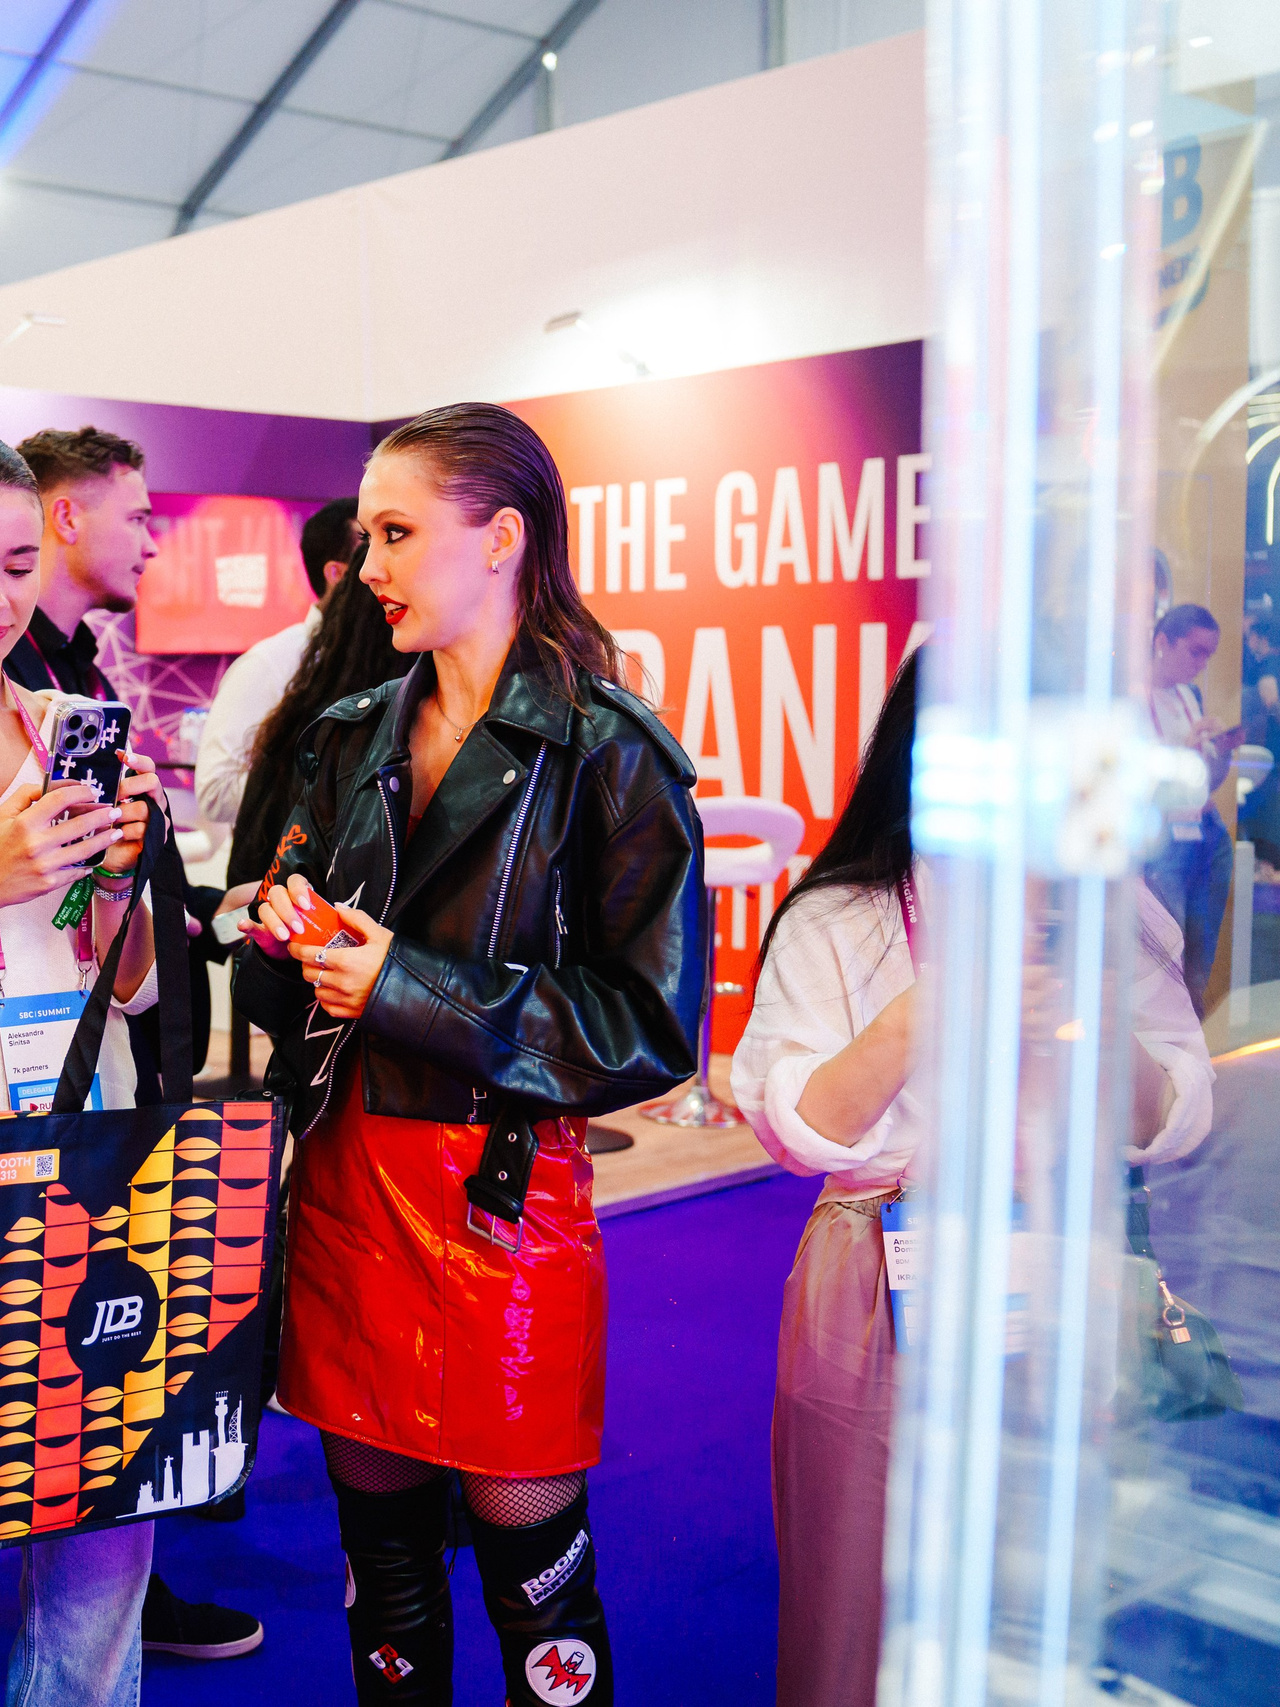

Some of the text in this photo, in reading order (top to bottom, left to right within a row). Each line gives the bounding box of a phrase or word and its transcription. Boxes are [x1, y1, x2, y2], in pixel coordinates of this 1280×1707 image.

[570, 453, 932, 595] THE GAME
[70, 889, 81, 902] SBC
[19, 1007, 71, 1019] SBC SUMMIT
[8, 1030, 44, 1039] Aleksandra
[8, 1039, 31, 1047] Sinitsa
[22, 1064, 49, 1074] partners
[22, 1086, 53, 1095] DELEGATE
[81, 1295, 144, 1345] JDB
